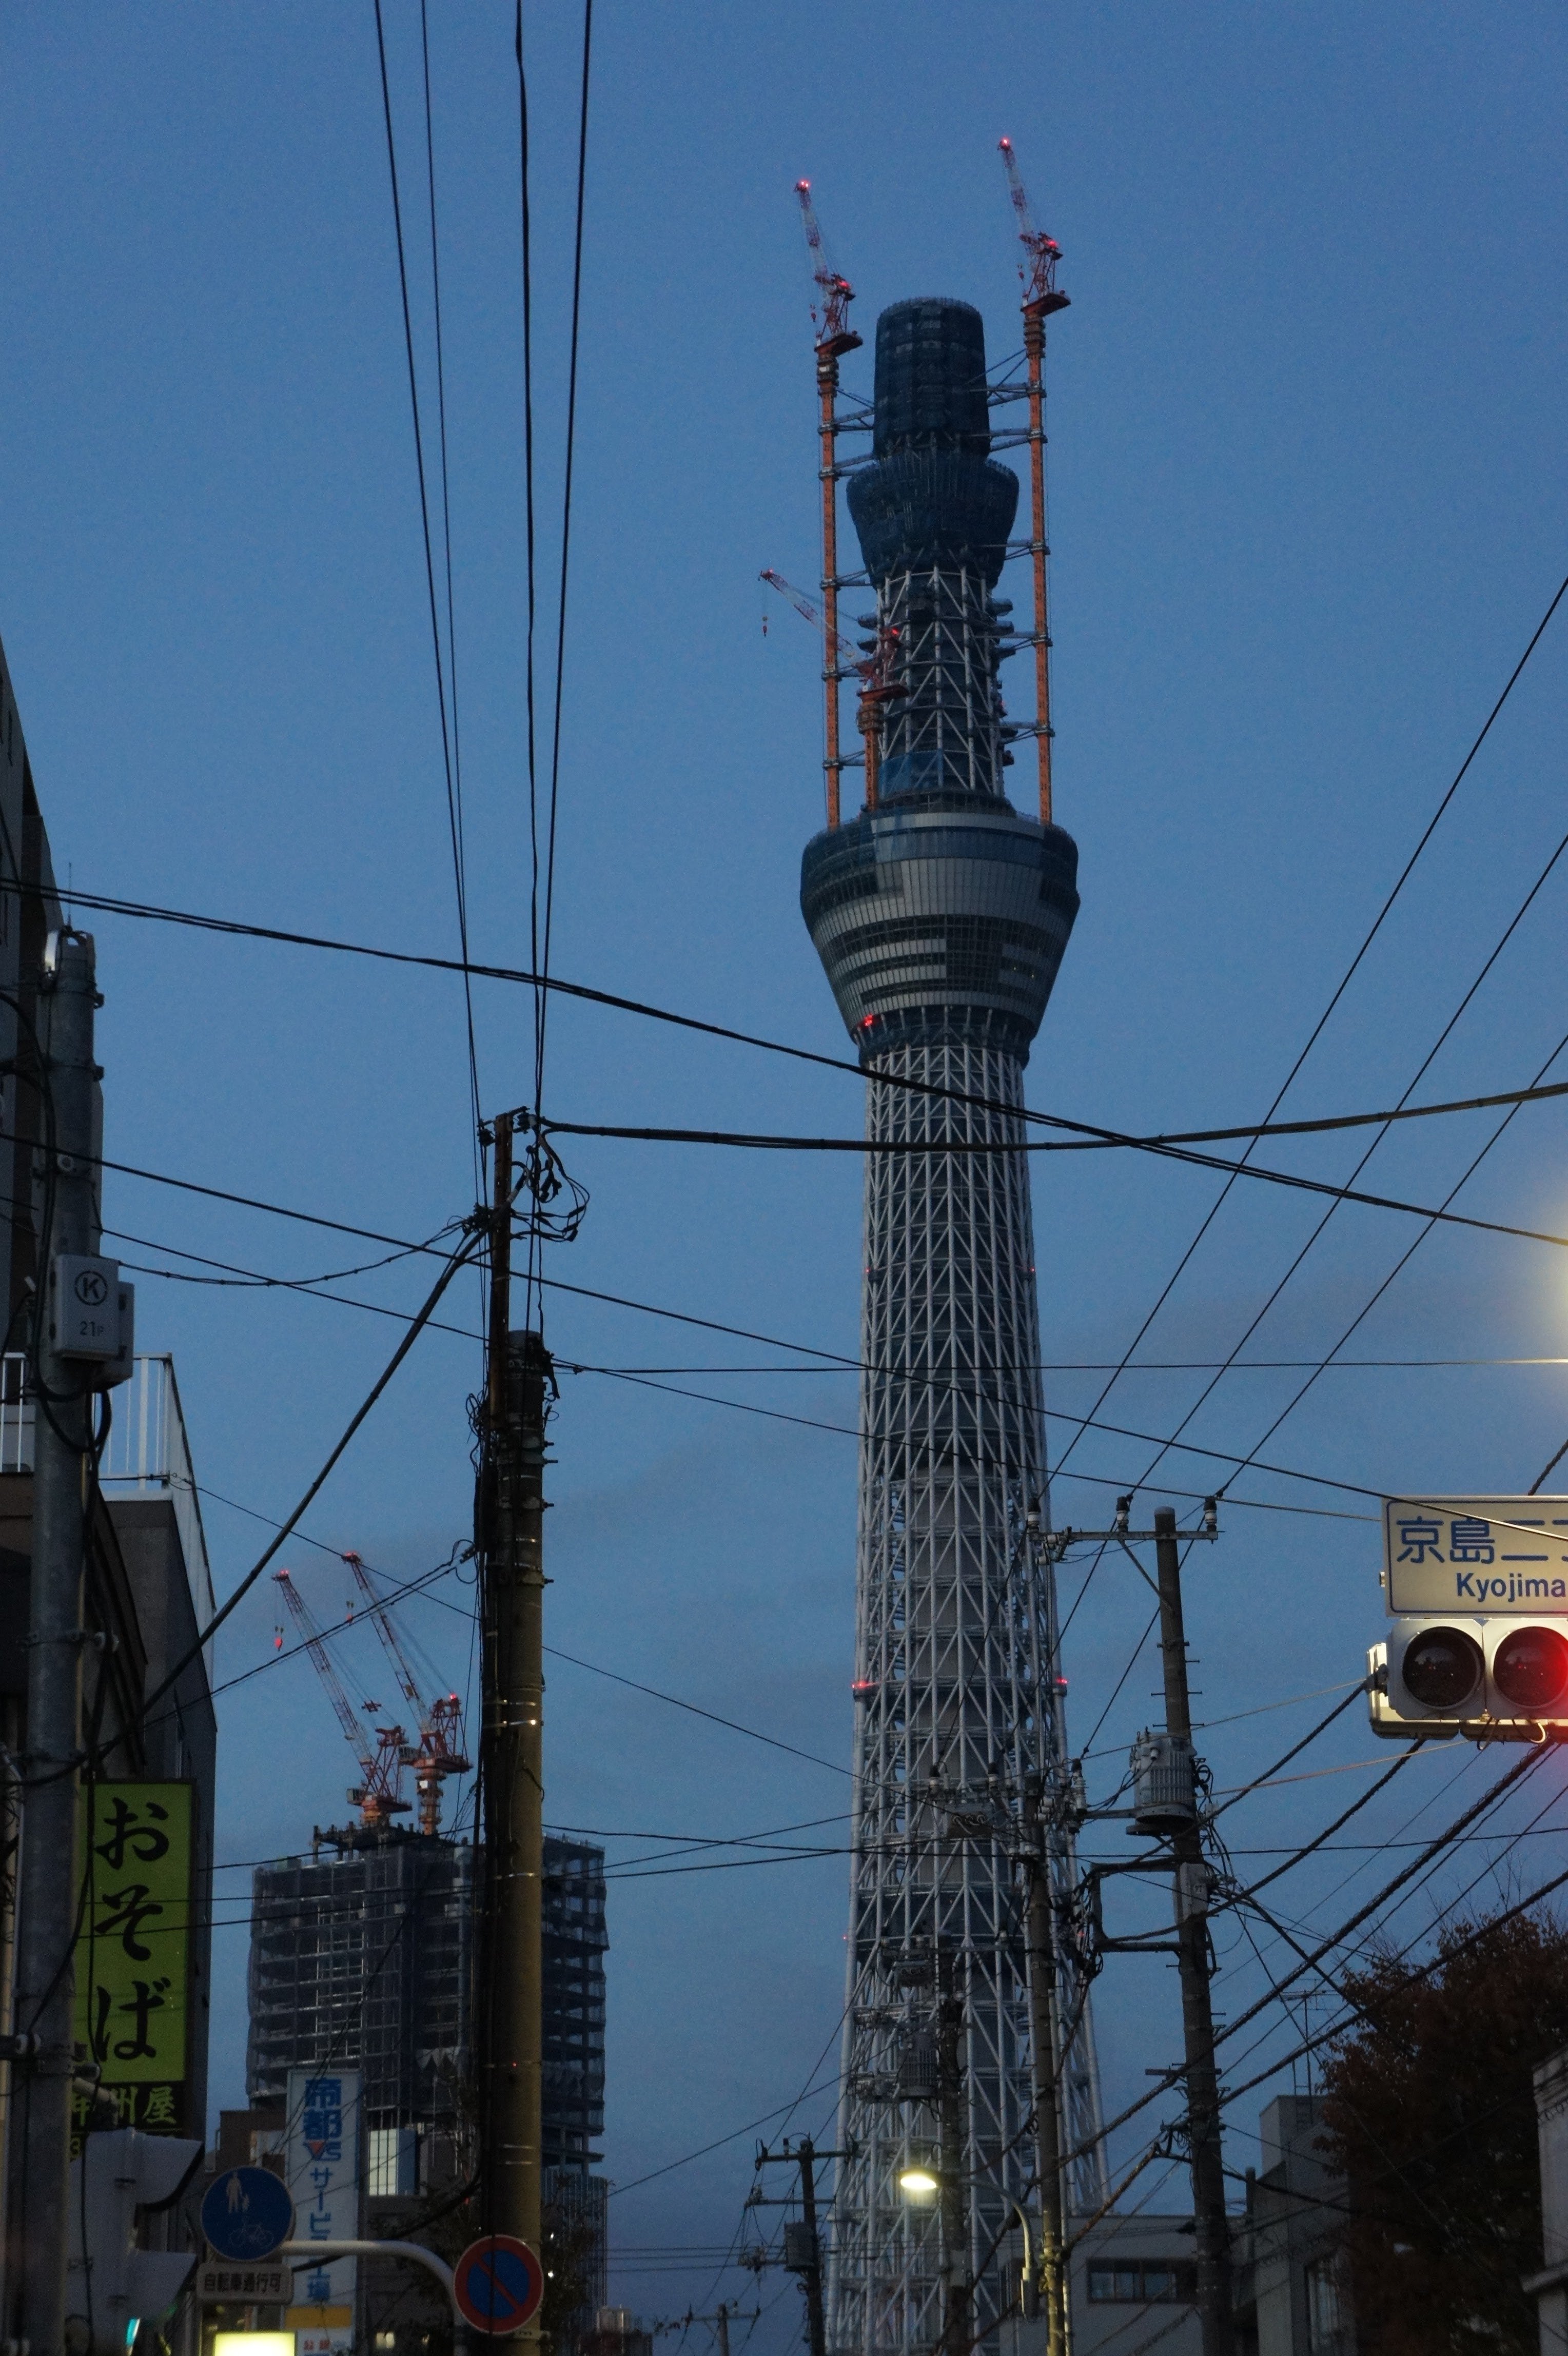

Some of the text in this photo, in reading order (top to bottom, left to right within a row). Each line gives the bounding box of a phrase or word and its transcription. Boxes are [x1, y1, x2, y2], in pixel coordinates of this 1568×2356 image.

[1456, 1573, 1566, 1603] Kyojima
[94, 1797, 170, 2062] おそば
[308, 2168, 333, 2302] サービ工場
[204, 2272, 281, 2293] 自転車通行可
